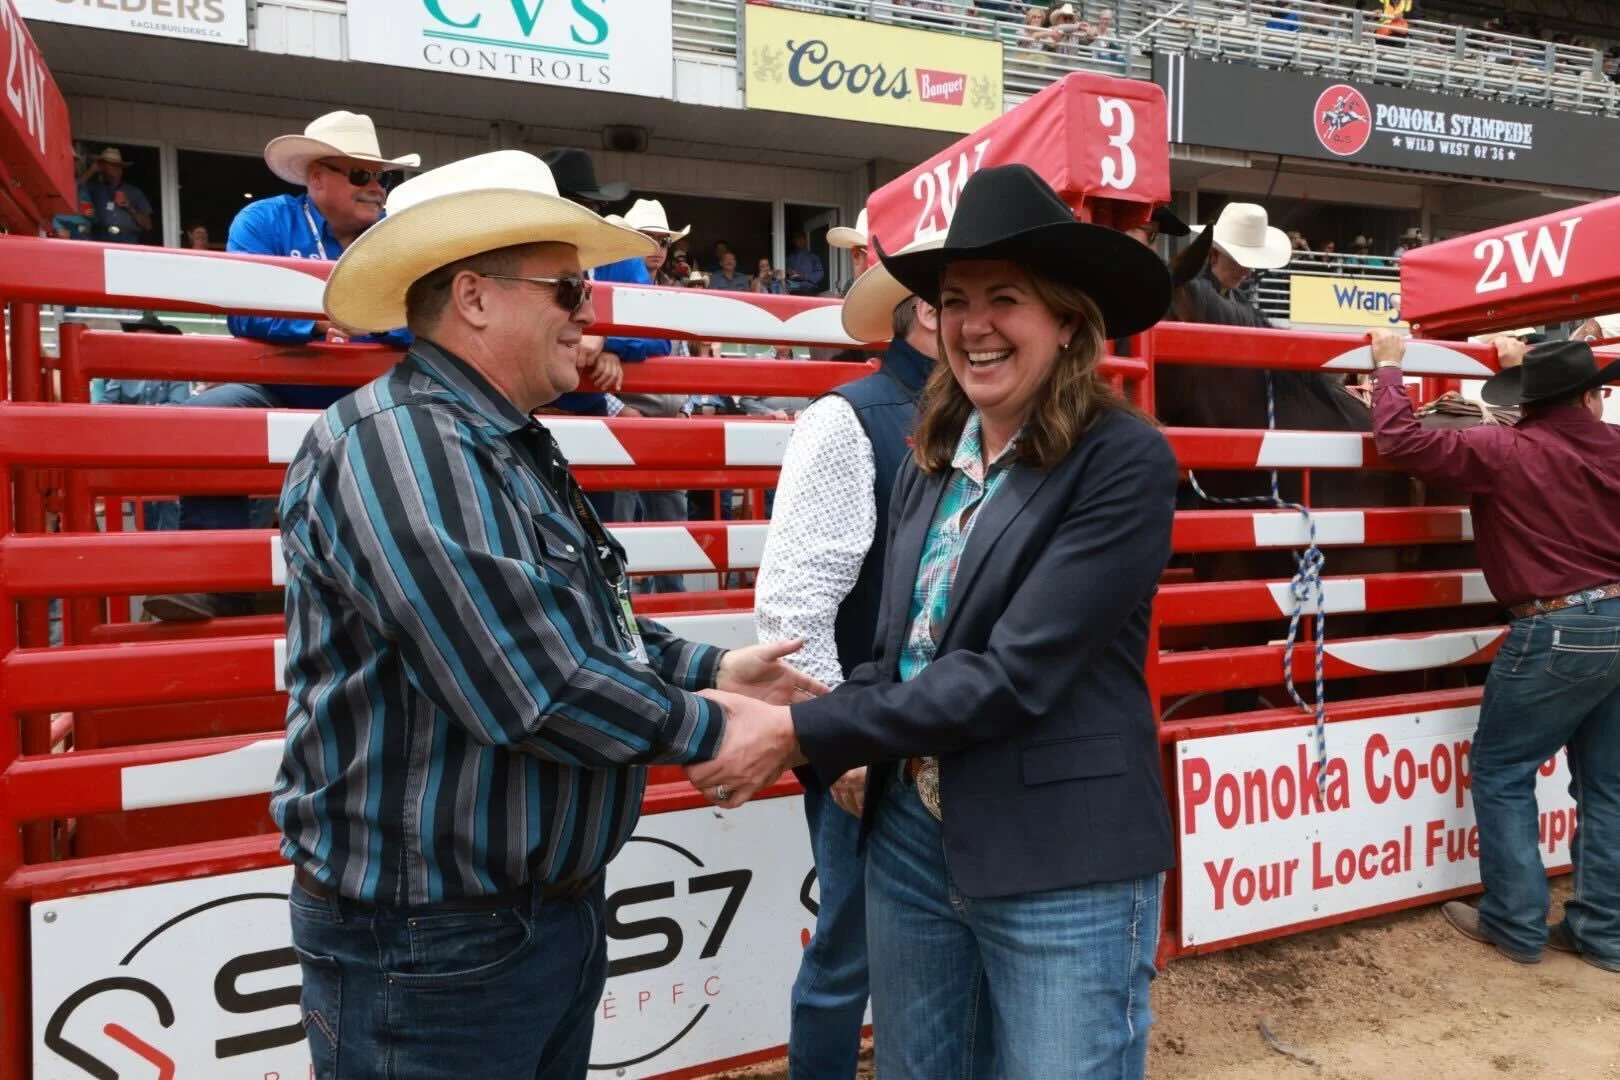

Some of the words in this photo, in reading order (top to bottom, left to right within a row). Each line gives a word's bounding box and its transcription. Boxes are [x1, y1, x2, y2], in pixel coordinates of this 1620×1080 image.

[130, 20, 222, 37] EAGLEBUILDERS.CA
[423, 43, 611, 84] CONTROLS
[786, 40, 911, 99] Coors
[921, 74, 963, 99] Banquet
[1097, 95, 1137, 190] 3
[1376, 103, 1446, 134] PONOKA
[1450, 113, 1533, 144] STAMPEDE
[1405, 136, 1435, 153] WILD
[1440, 141, 1470, 157] WEST
[1474, 145, 1488, 159] OF
[1473, 217, 1583, 294] 2W
[1333, 284, 1401, 323] Wrang
[1181, 743, 1349, 835] Ponoka
[1364, 732, 1473, 809] Co-op
[1203, 857, 1300, 911] Your
[1311, 825, 1412, 890] Local
